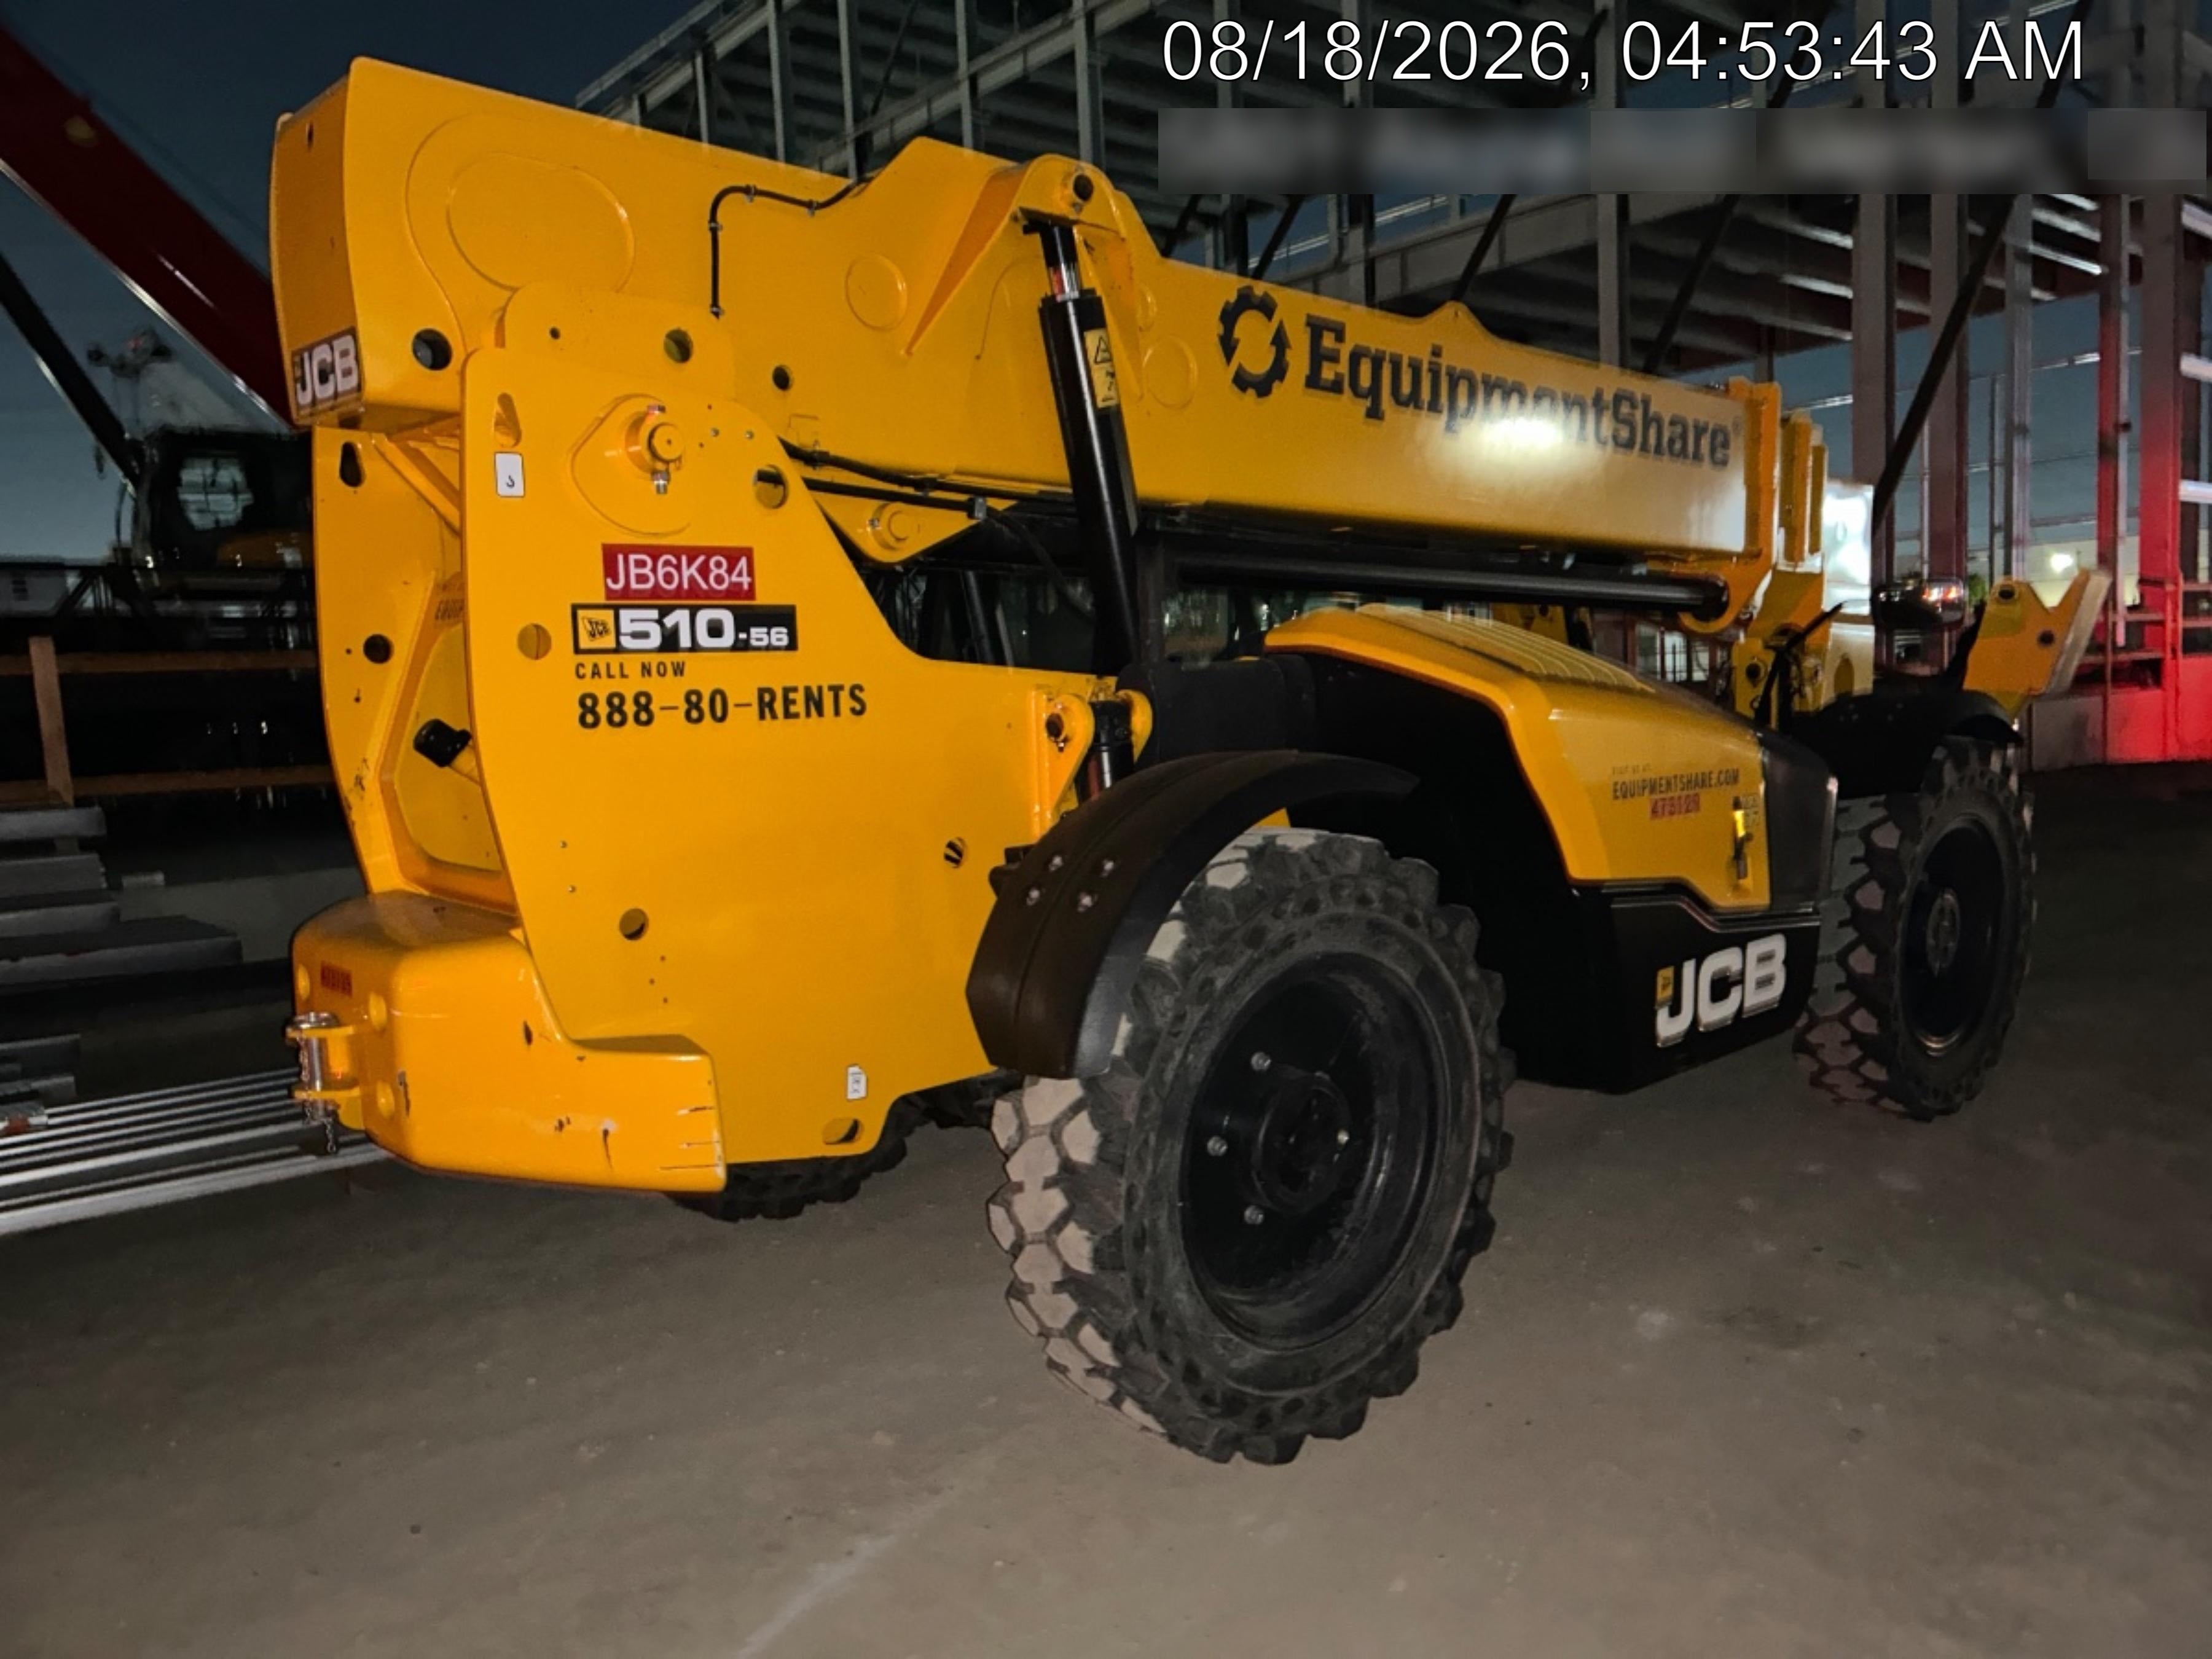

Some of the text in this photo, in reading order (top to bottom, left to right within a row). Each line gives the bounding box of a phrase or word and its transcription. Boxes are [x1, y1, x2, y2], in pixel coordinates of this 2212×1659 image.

[296, 334, 359, 405] JCB
[1303, 313, 1732, 469] EquipmentShare
[606, 554, 752, 590] JB6K84
[619, 608, 790, 649] 510-56
[575, 661, 686, 679] CALL NOW
[578, 683, 867, 729] 888-80-RENTS
[1612, 769, 1739, 800] EQUIPMENTSHARE.COM
[1656, 933, 1786, 1046] JCB
